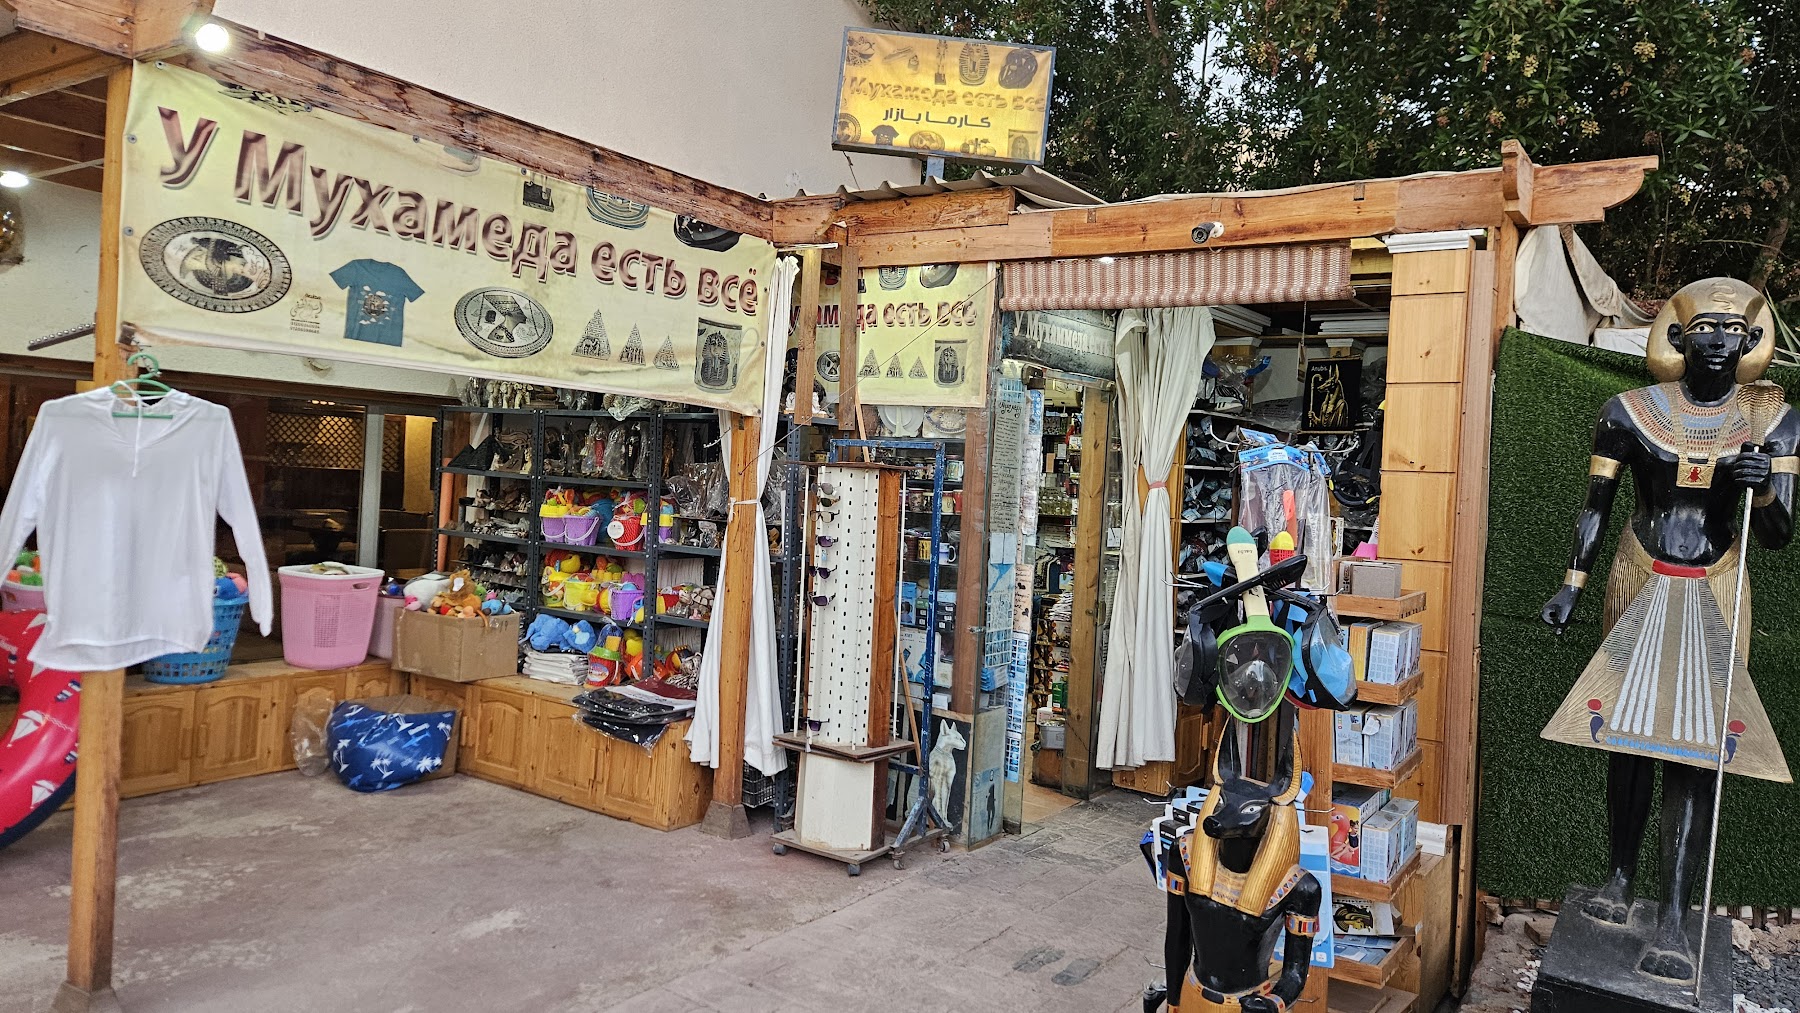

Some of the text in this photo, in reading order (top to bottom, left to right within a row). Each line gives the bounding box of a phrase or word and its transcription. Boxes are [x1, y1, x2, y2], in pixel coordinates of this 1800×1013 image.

[882, 107, 992, 129] كارما بازار
[157, 105, 759, 316] У Мухамеда есть всё
[883, 302, 932, 328] есть
